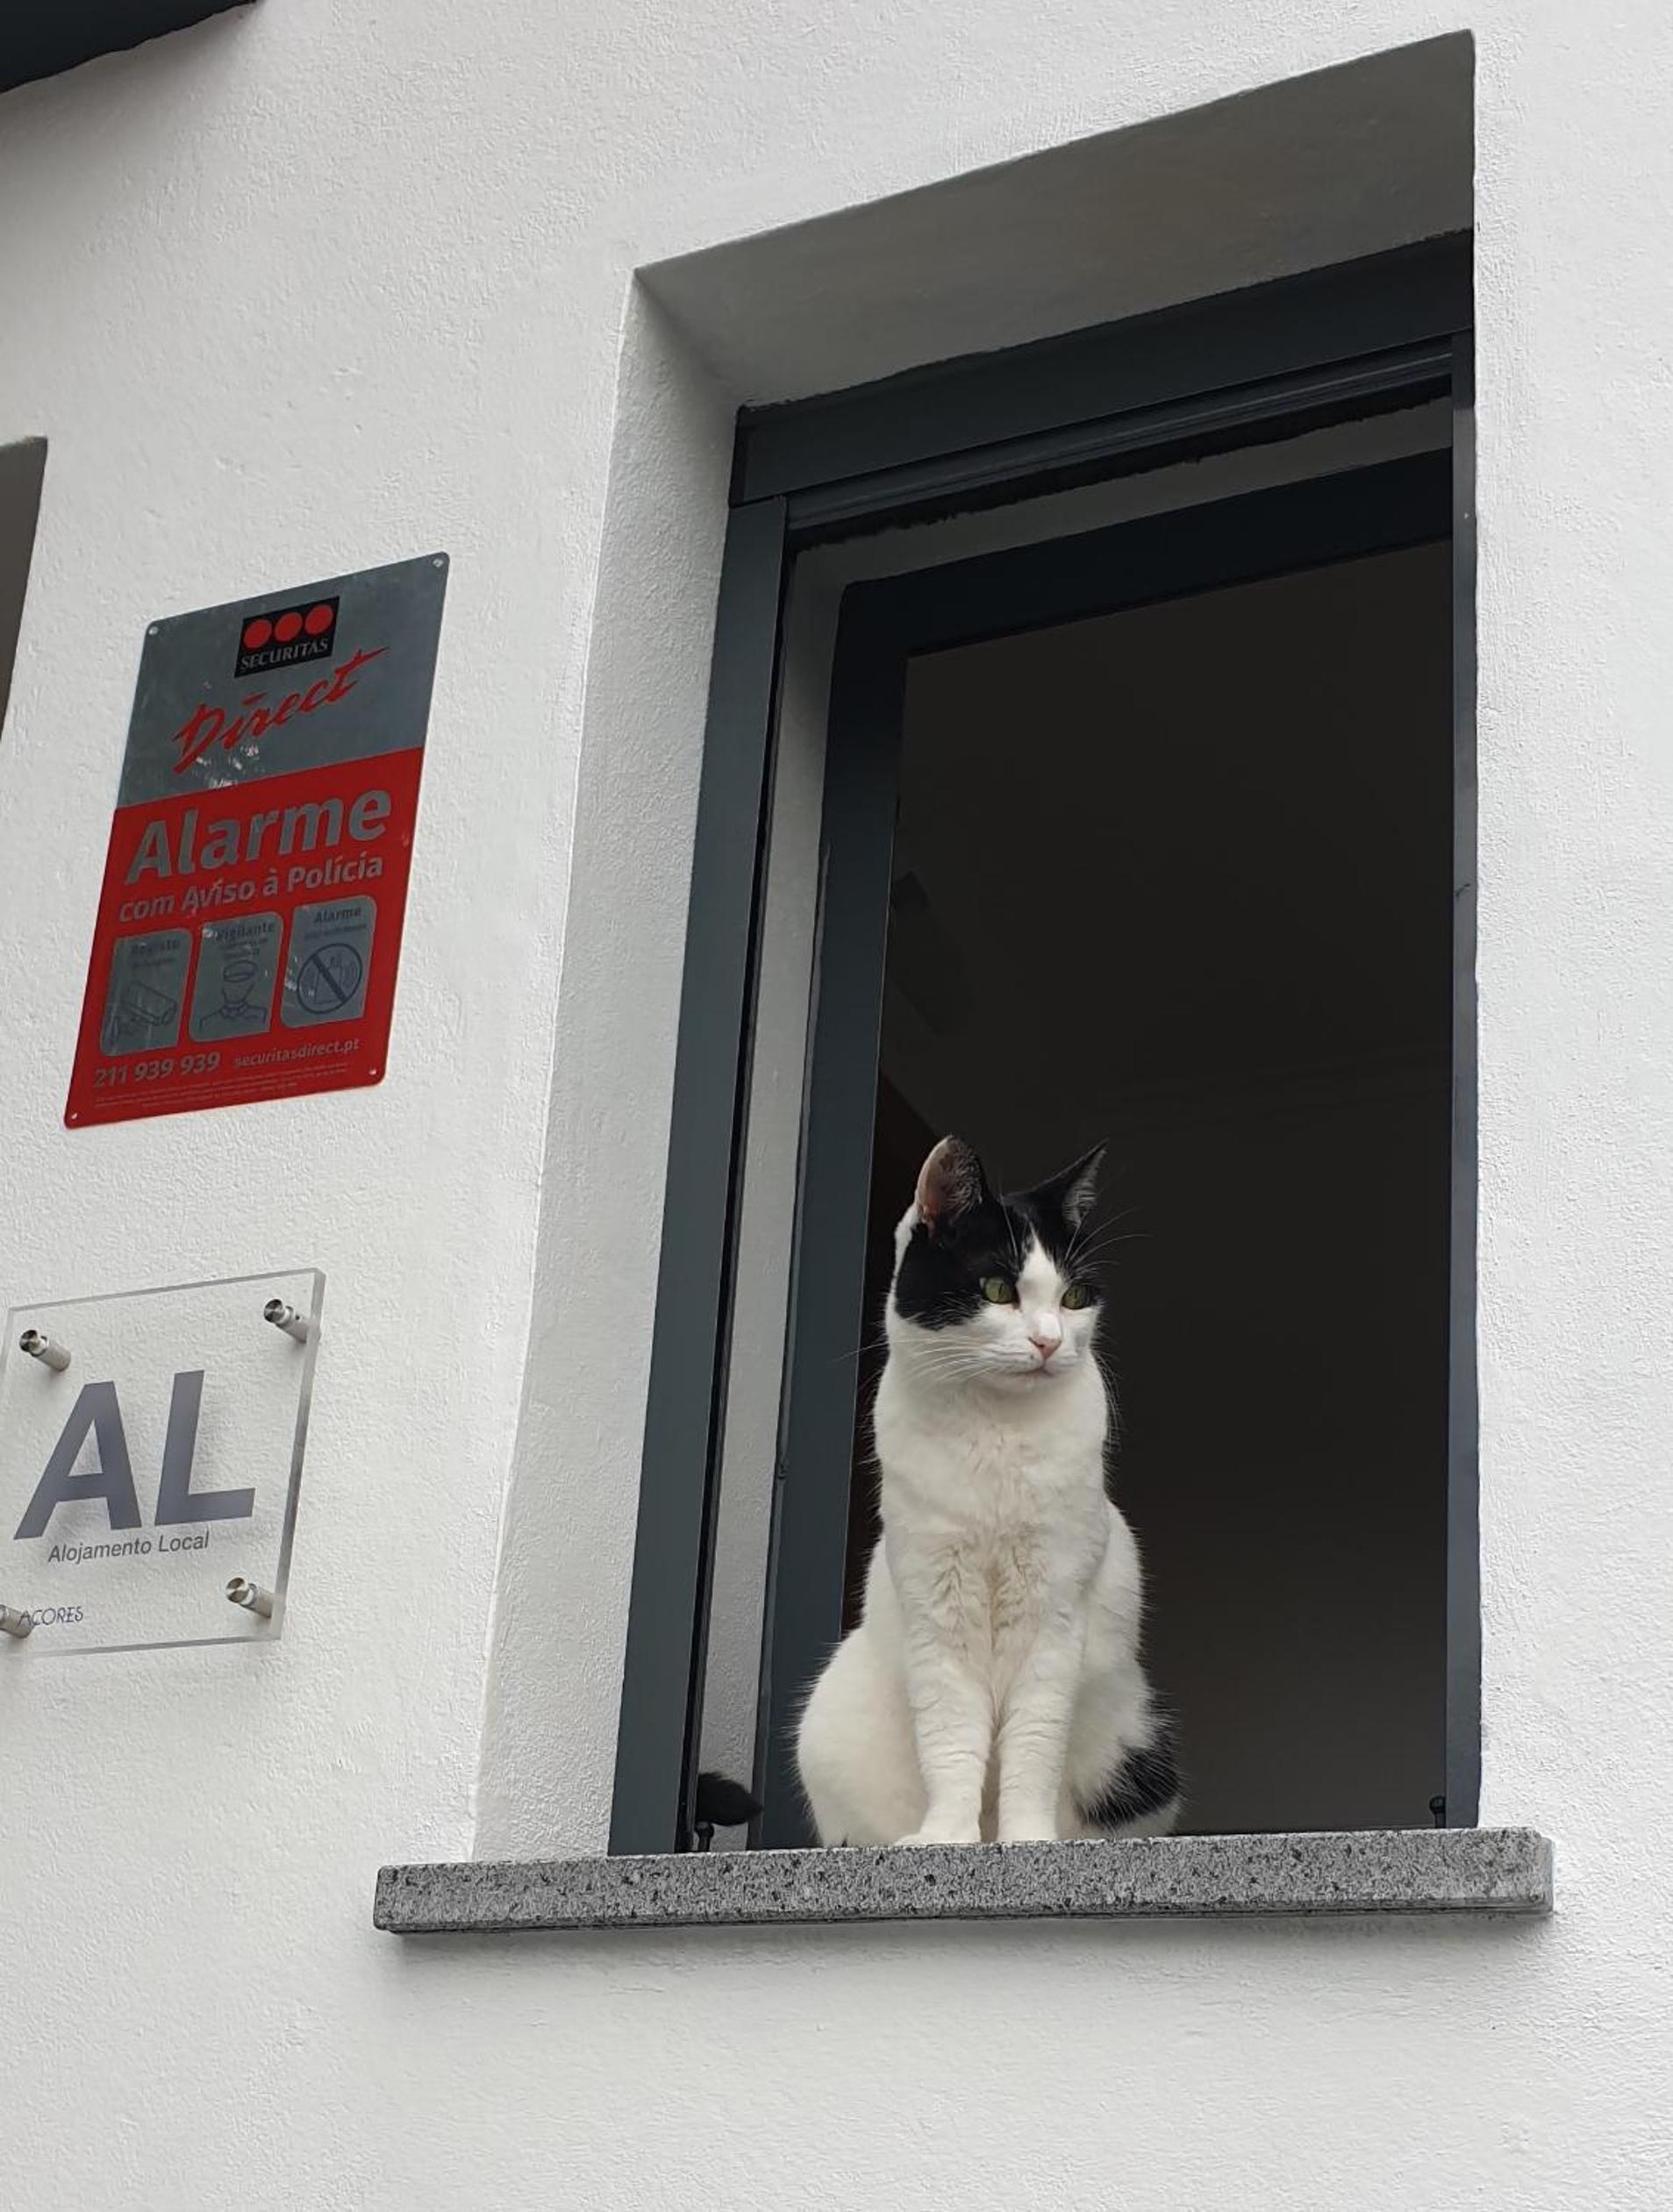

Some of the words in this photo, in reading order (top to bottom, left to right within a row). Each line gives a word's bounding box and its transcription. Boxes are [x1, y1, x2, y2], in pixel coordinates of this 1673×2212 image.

[240, 638, 330, 668] SECURITAS
[171, 647, 390, 774] Direct
[125, 789, 391, 886] Alarme
[118, 894, 175, 923] com
[182, 879, 255, 911] Aviso
[263, 867, 279, 896] à
[287, 851, 383, 892] Polícia
[313, 907, 361, 923] Alarme
[93, 1066, 127, 1088] 211
[134, 1060, 174, 1082] 939
[180, 1052, 220, 1074] 939
[233, 1038, 360, 1067] securitasdirect.pt
[13, 1370, 255, 1540] AL
[47, 1536, 152, 1566] Alojamento
[158, 1531, 210, 1554] Local
